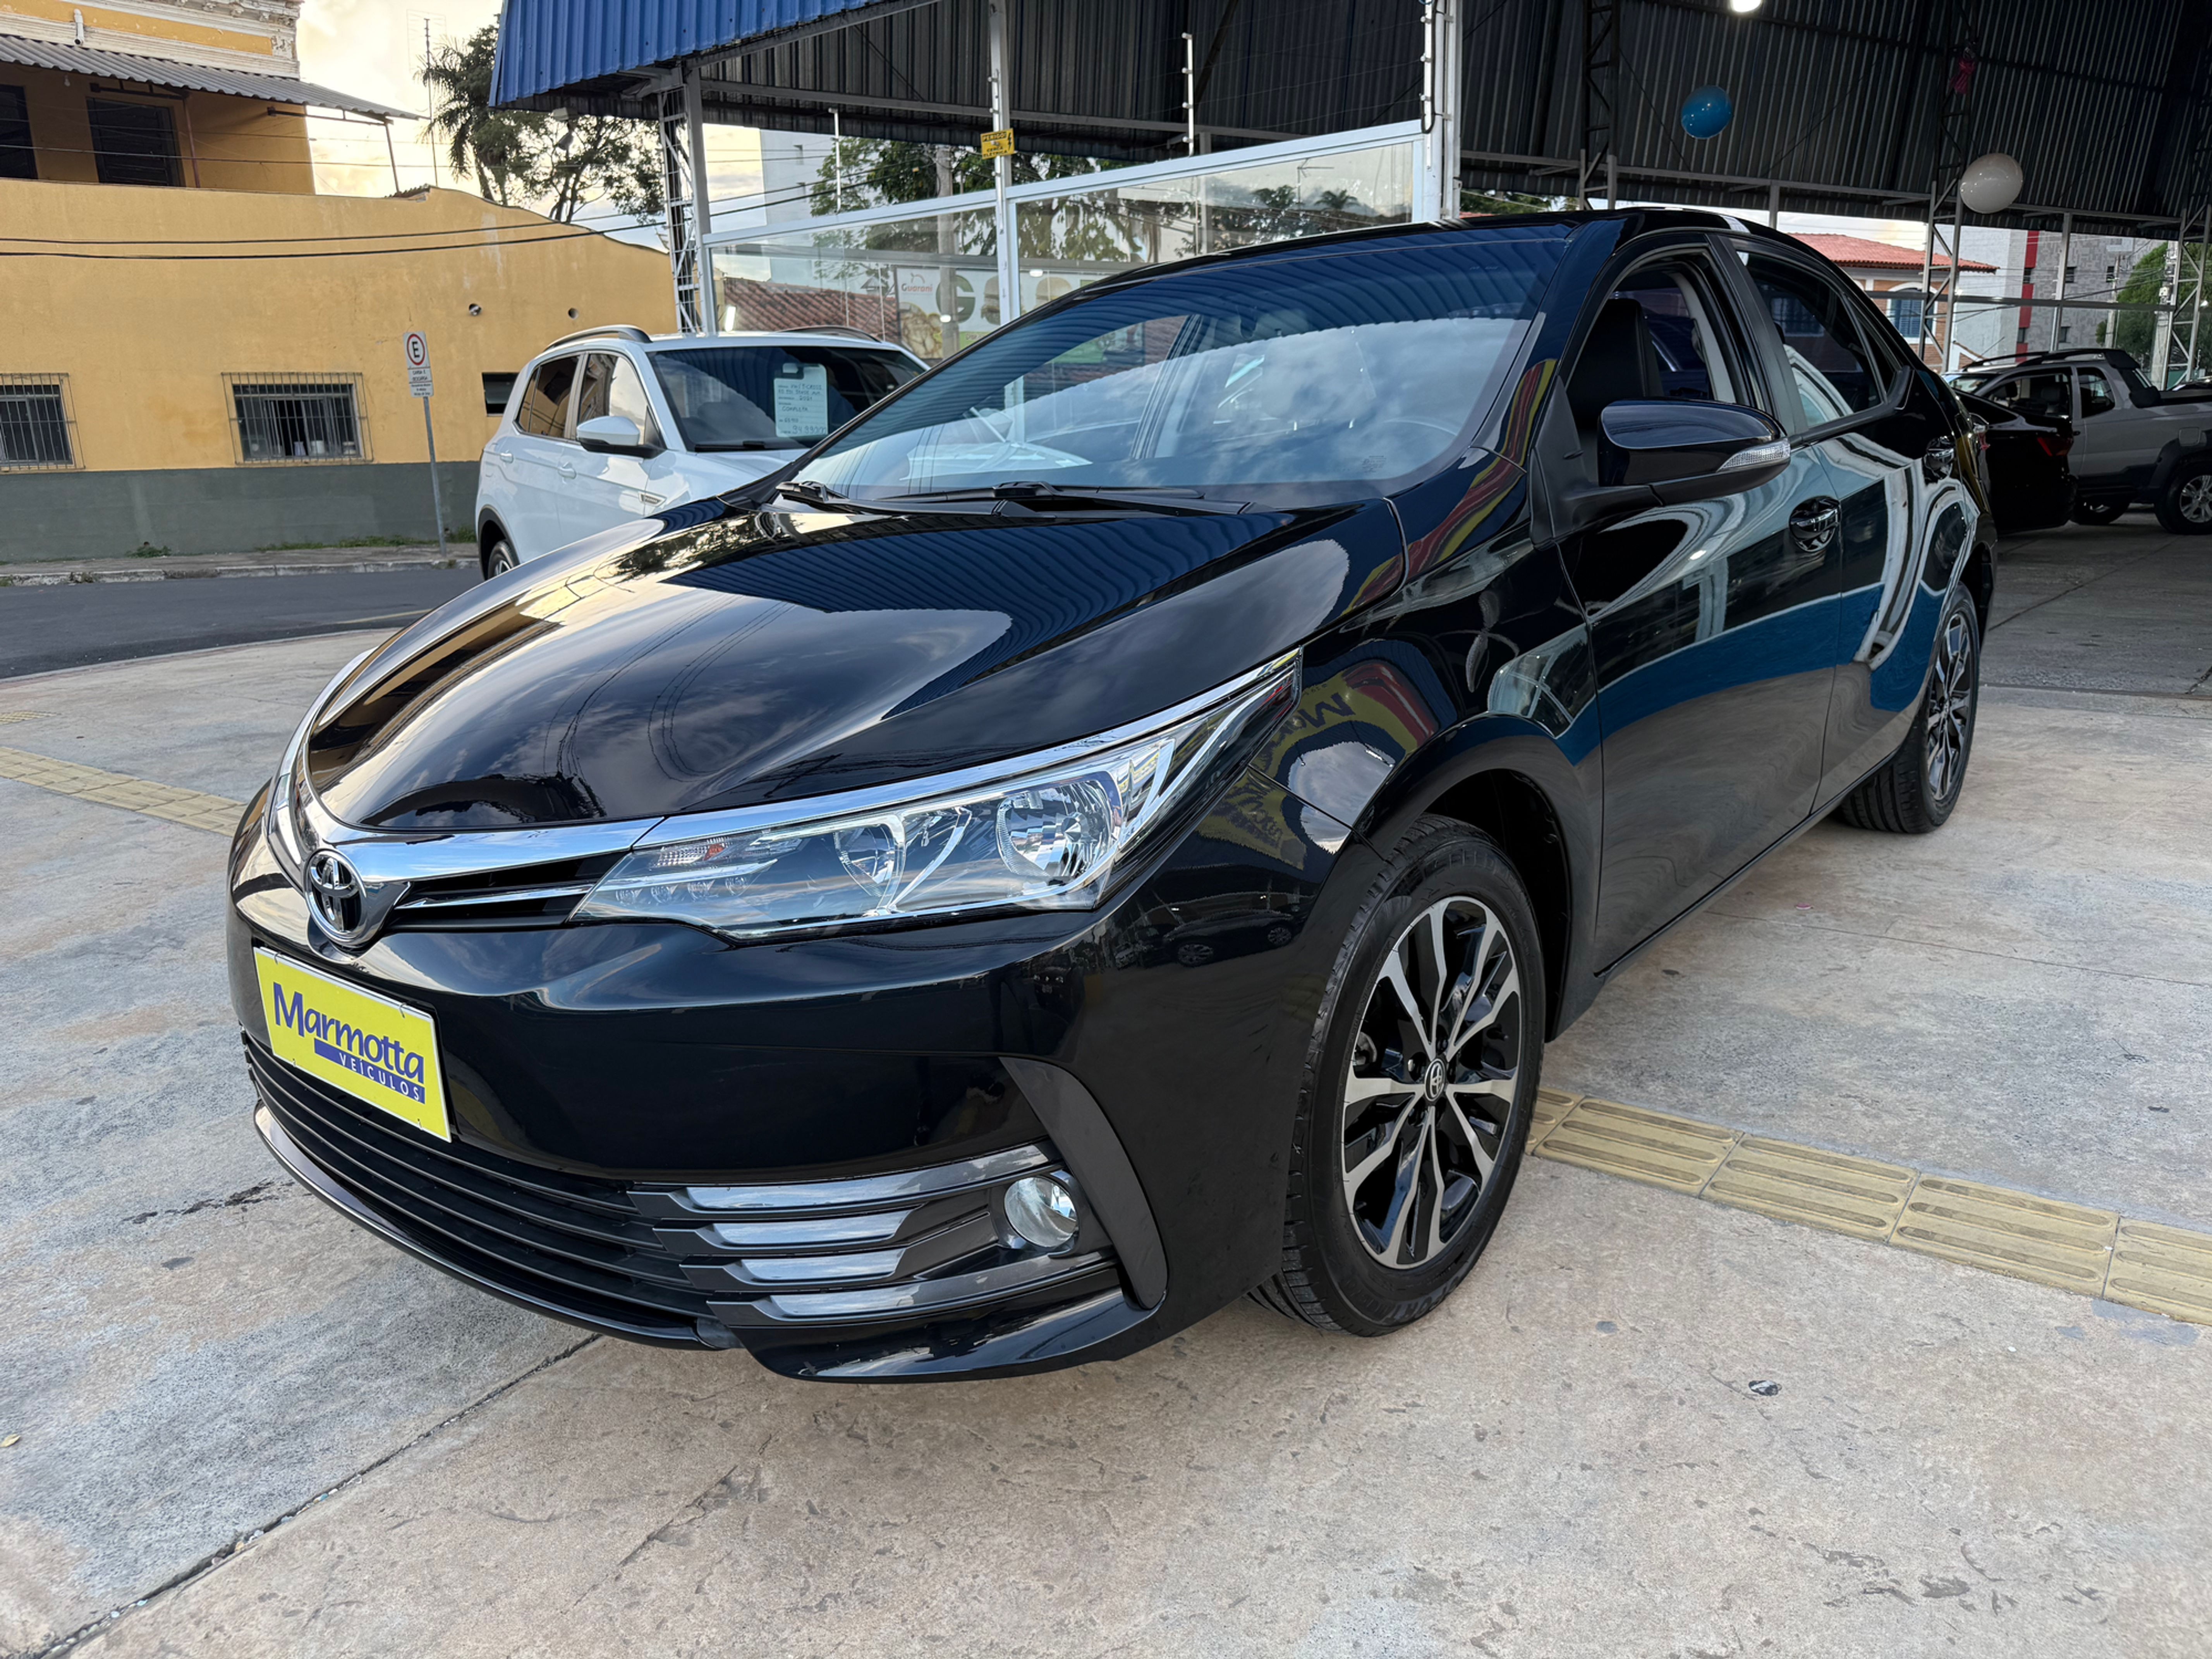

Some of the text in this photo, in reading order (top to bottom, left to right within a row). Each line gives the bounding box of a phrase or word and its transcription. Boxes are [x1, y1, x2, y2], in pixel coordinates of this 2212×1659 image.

[901, 283, 933, 293] Guarani
[412, 341, 420, 358] E
[273, 982, 424, 1084] Marmotta
[339, 1053, 419, 1101] VEÍCULOS
